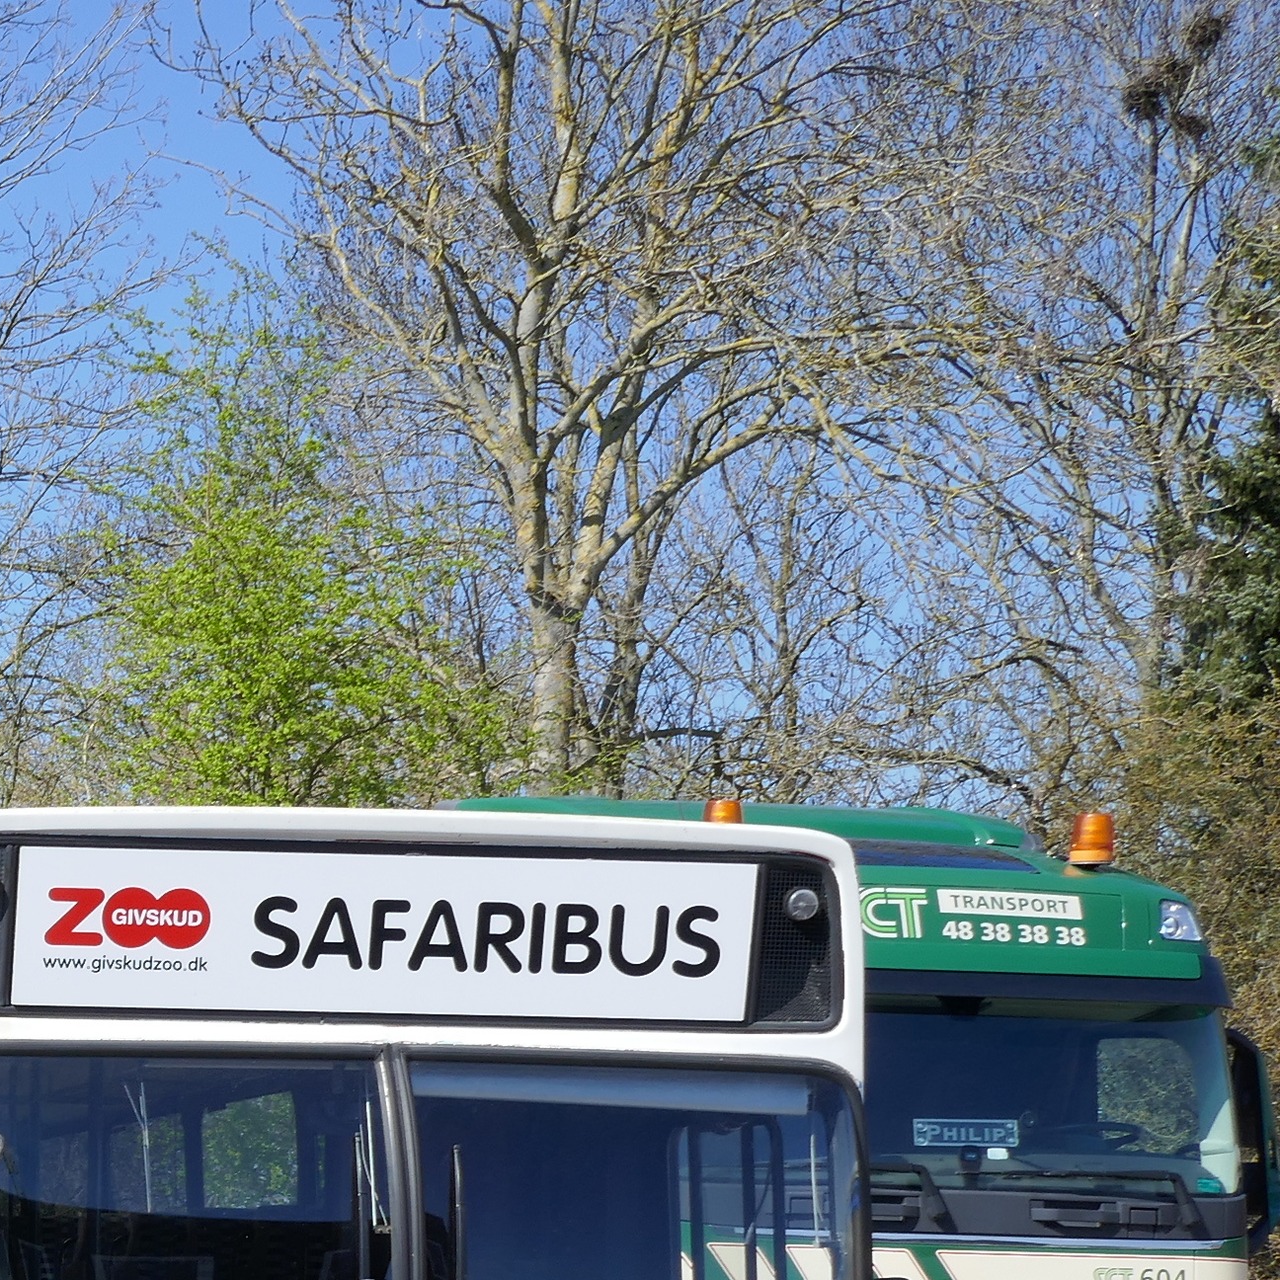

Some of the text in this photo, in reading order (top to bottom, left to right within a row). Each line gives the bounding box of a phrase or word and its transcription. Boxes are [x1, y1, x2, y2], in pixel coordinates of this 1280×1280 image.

[859, 887, 928, 938] CT
[950, 894, 1068, 914] TRANSPORT
[44, 887, 211, 949] ZOO
[111, 908, 203, 927] GIVSKUD
[251, 896, 721, 978] SAFARIBUS
[942, 921, 1086, 946] 48 38 38 38
[43, 955, 208, 973] www.givskudzoo.dk
[925, 1125, 1006, 1141] PHILIP
